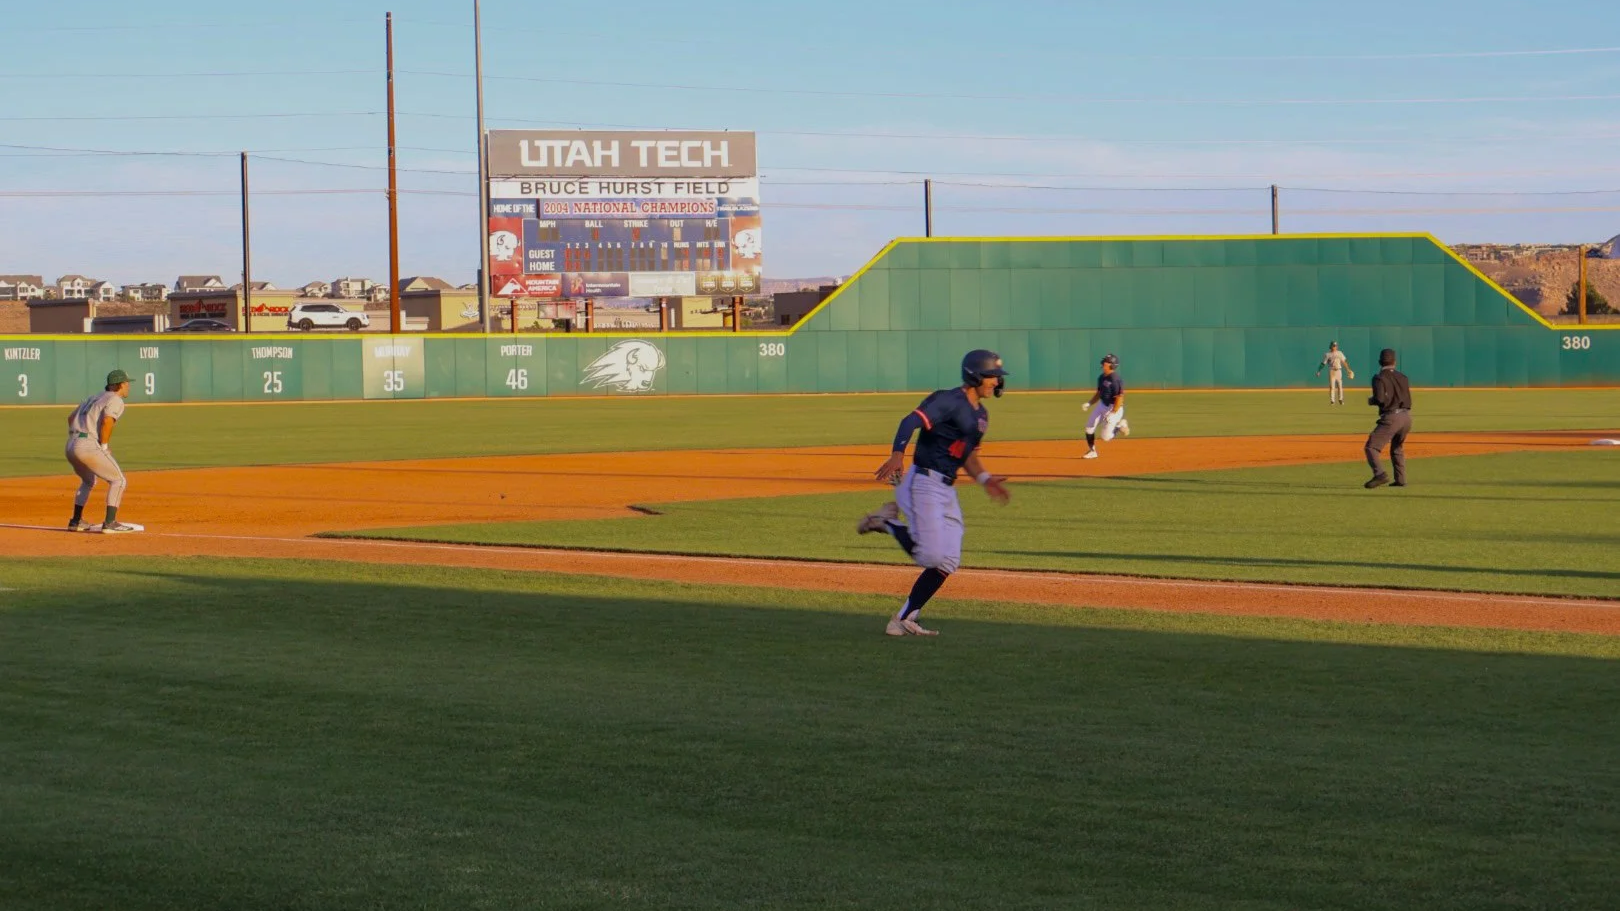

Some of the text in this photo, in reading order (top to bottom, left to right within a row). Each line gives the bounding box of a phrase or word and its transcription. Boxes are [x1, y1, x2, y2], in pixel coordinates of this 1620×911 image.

[519, 140, 729, 167] UTAH TECH
[520, 182, 730, 195] BRUCE HURST FIELD
[493, 204, 535, 213] HOME OF THE
[544, 202, 569, 213] 2004
[573, 202, 637, 213] NATIONAL
[641, 202, 715, 213] CHAMPIONS
[540, 220, 556, 228] MPH
[584, 220, 604, 228] BALL
[623, 220, 649, 228] STRIKE
[669, 220, 684, 228] OUT
[528, 249, 556, 259] GUEST
[529, 261, 556, 271] HOME
[1562, 336, 1590, 349] 380
[4, 347, 41, 360] KINTZLER
[140, 347, 159, 359] LYON
[251, 346, 293, 359] THOMPSON
[500, 345, 532, 356] PORTER
[759, 343, 785, 356] 380
[18, 374, 28, 397] 3
[145, 373, 155, 395] 9
[263, 371, 283, 393] 25
[383, 370, 404, 392] 35
[505, 368, 528, 390] 46
